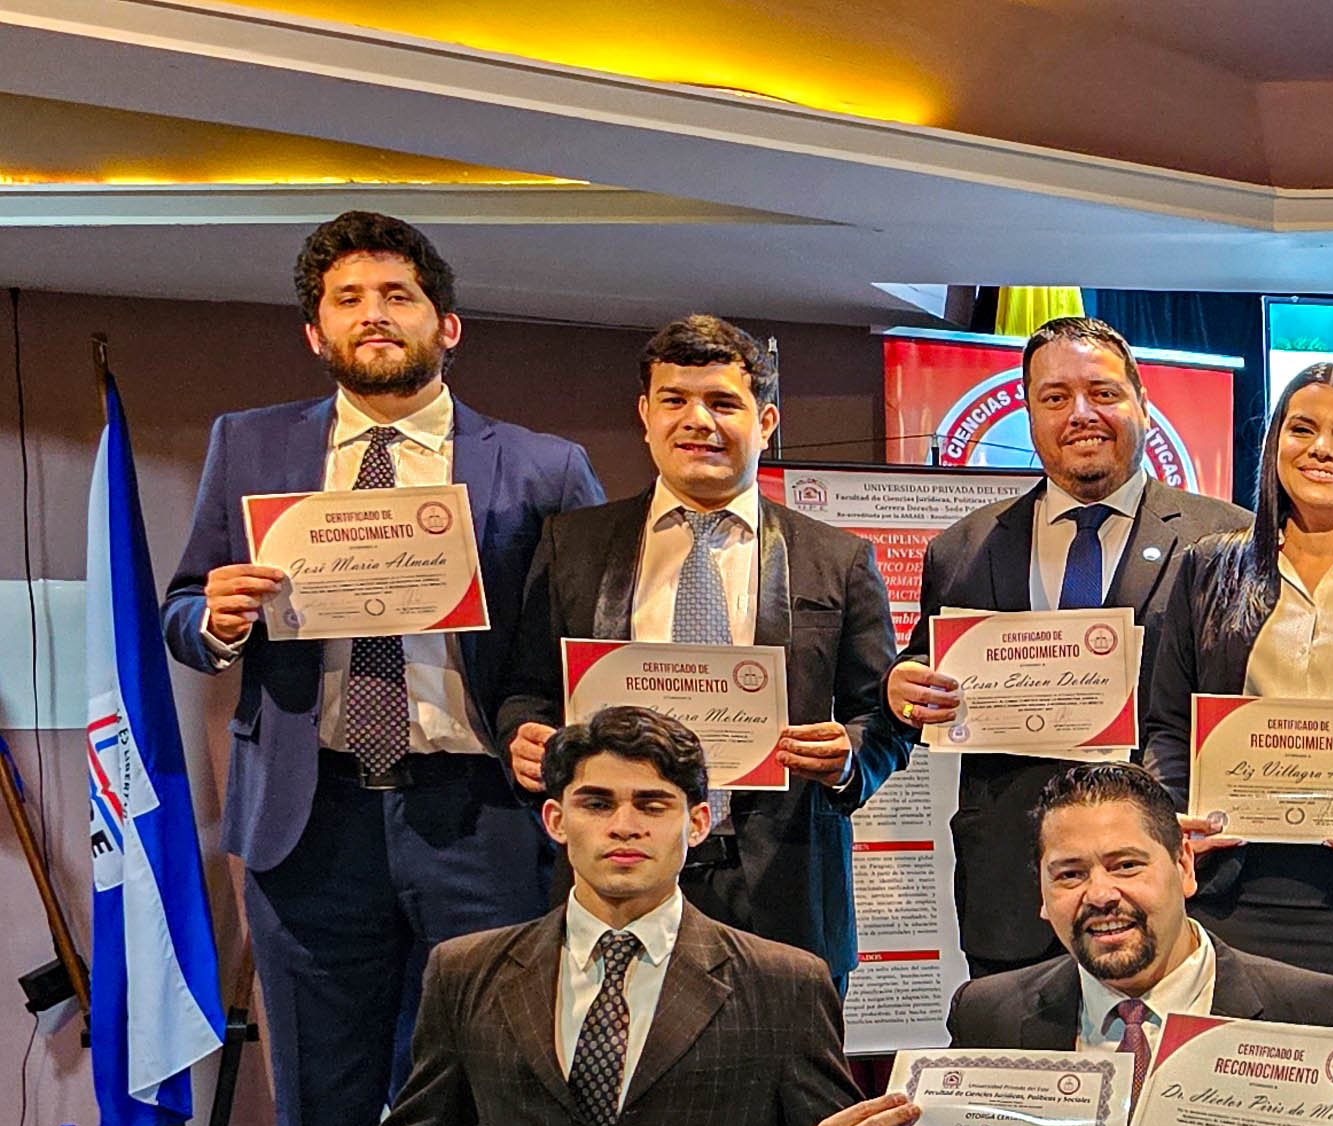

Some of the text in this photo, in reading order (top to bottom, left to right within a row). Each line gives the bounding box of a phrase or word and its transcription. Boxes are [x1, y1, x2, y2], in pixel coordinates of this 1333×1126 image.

[947, 389, 1012, 460] CIENCIAS
[864, 483, 930, 493] UNIVERSIDAD
[932, 485, 974, 494] PRIVADA
[325, 510, 393, 523] CERTIFICADO DE
[310, 524, 414, 544] RECONOCIMIENTO
[385, 552, 447, 568] Almada
[1002, 631, 1063, 643] CERTIFICADO DE
[986, 644, 1080, 662] RECONOCIMIENTO
[643, 662, 709, 674] CERTIFICADO DE
[626, 677, 728, 693] RECONOCIMIENTO
[1004, 672, 1050, 688] Edison
[650, 705, 698, 722] Cbrera
[704, 707, 768, 724] Molinas
[1268, 719, 1330, 731] CERTIFICADO DE
[1225, 761, 1255, 781] Liz
[1262, 761, 1322, 784] Villagra
[1237, 1043, 1304, 1062] CERTIFICADO DE
[1214, 1058, 1319, 1084] RECONOCIMIENTO
[1161, 1084, 1185, 1100] Dr.
[1189, 1088, 1243, 1108] Héctor
